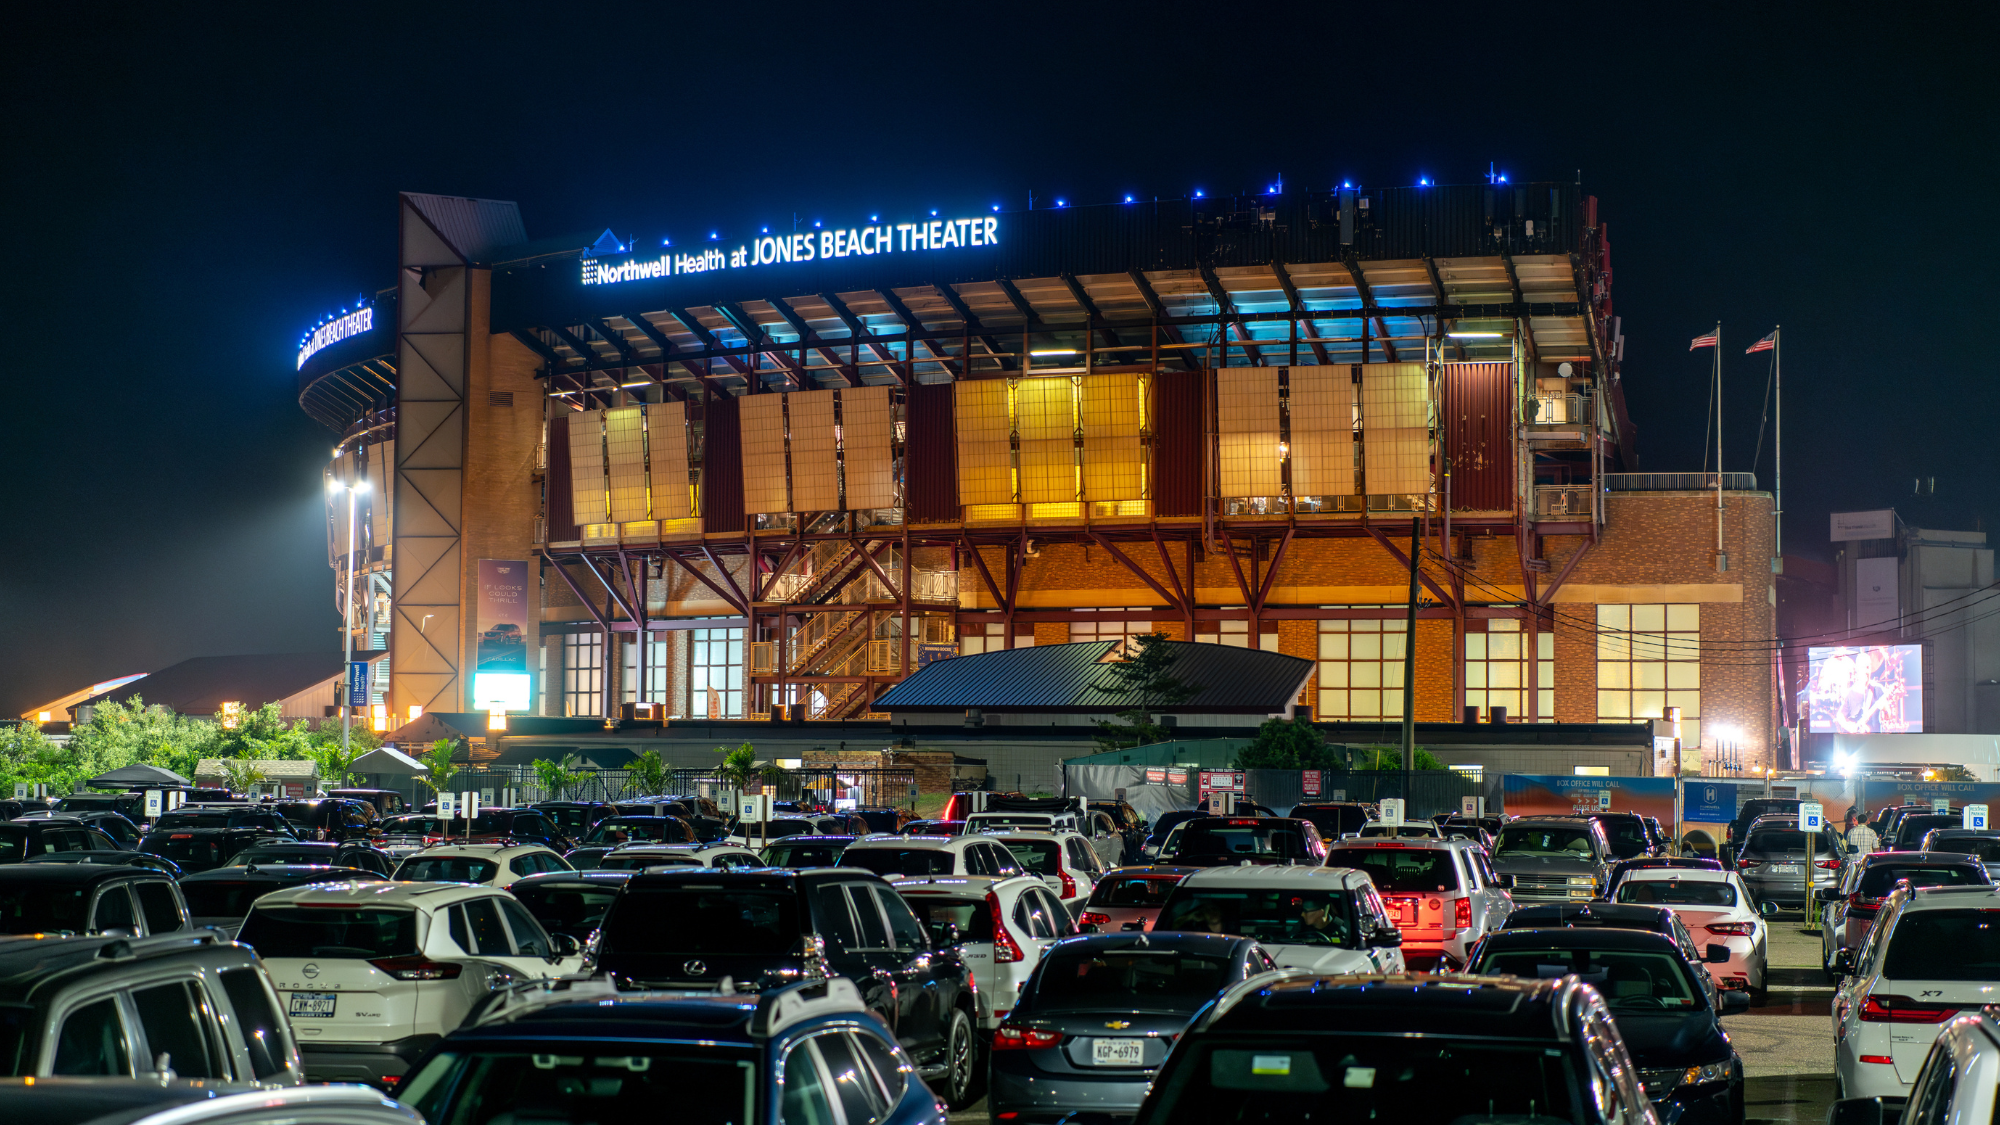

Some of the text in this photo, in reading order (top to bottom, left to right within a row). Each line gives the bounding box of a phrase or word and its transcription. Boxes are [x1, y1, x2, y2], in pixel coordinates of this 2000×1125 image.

[597, 217, 998, 285] Northwell Health at JONES BEACH THEATER
[344, 306, 372, 338] THEATER
[1556, 779, 1569, 787] BOX
[1605, 780, 1620, 788] CALL
[1897, 783, 1912, 791] BOX
[1914, 783, 1938, 791] OFFICE
